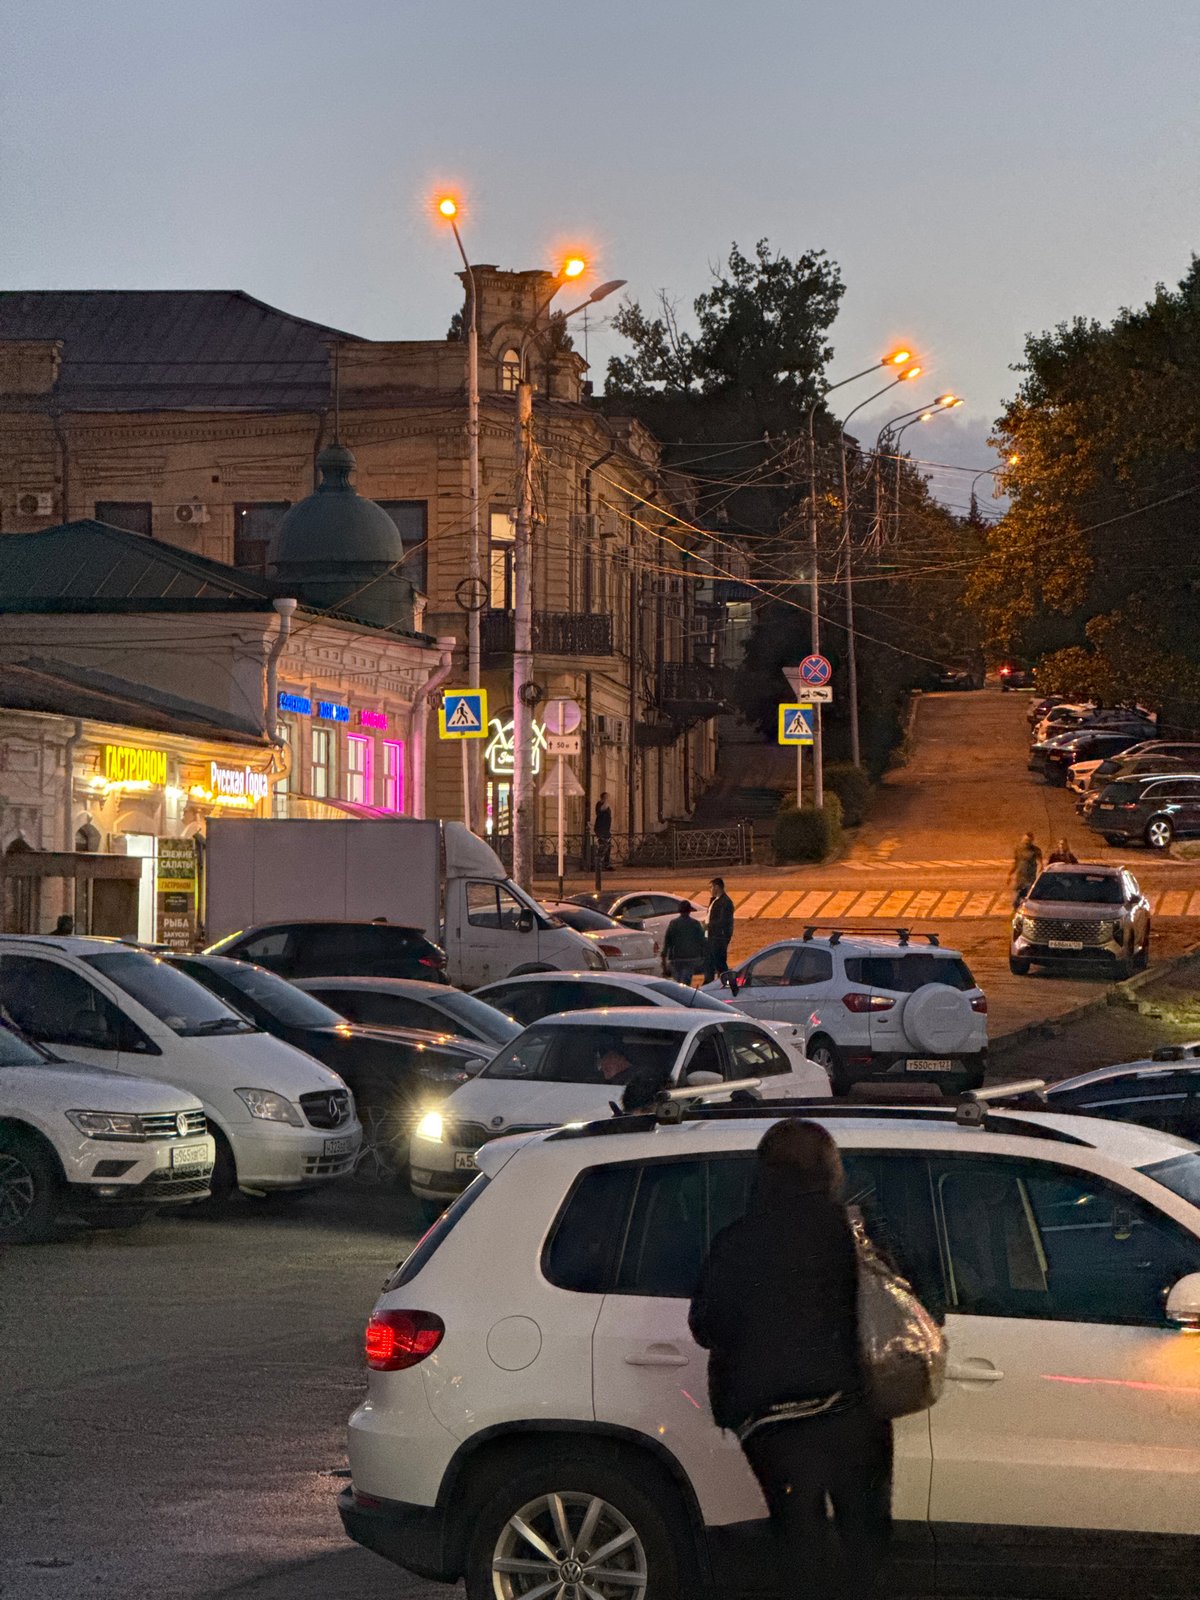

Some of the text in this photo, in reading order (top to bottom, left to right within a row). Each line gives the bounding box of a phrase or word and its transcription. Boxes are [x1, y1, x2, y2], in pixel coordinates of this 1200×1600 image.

[556, 741, 565, 749] 50
[106, 745, 167, 785] ГАСТРОНОМ
[160, 860, 193, 868] САЛАТЫ
[163, 918, 189, 927] РЫБА
[169, 939, 189, 947] ПИВУ
